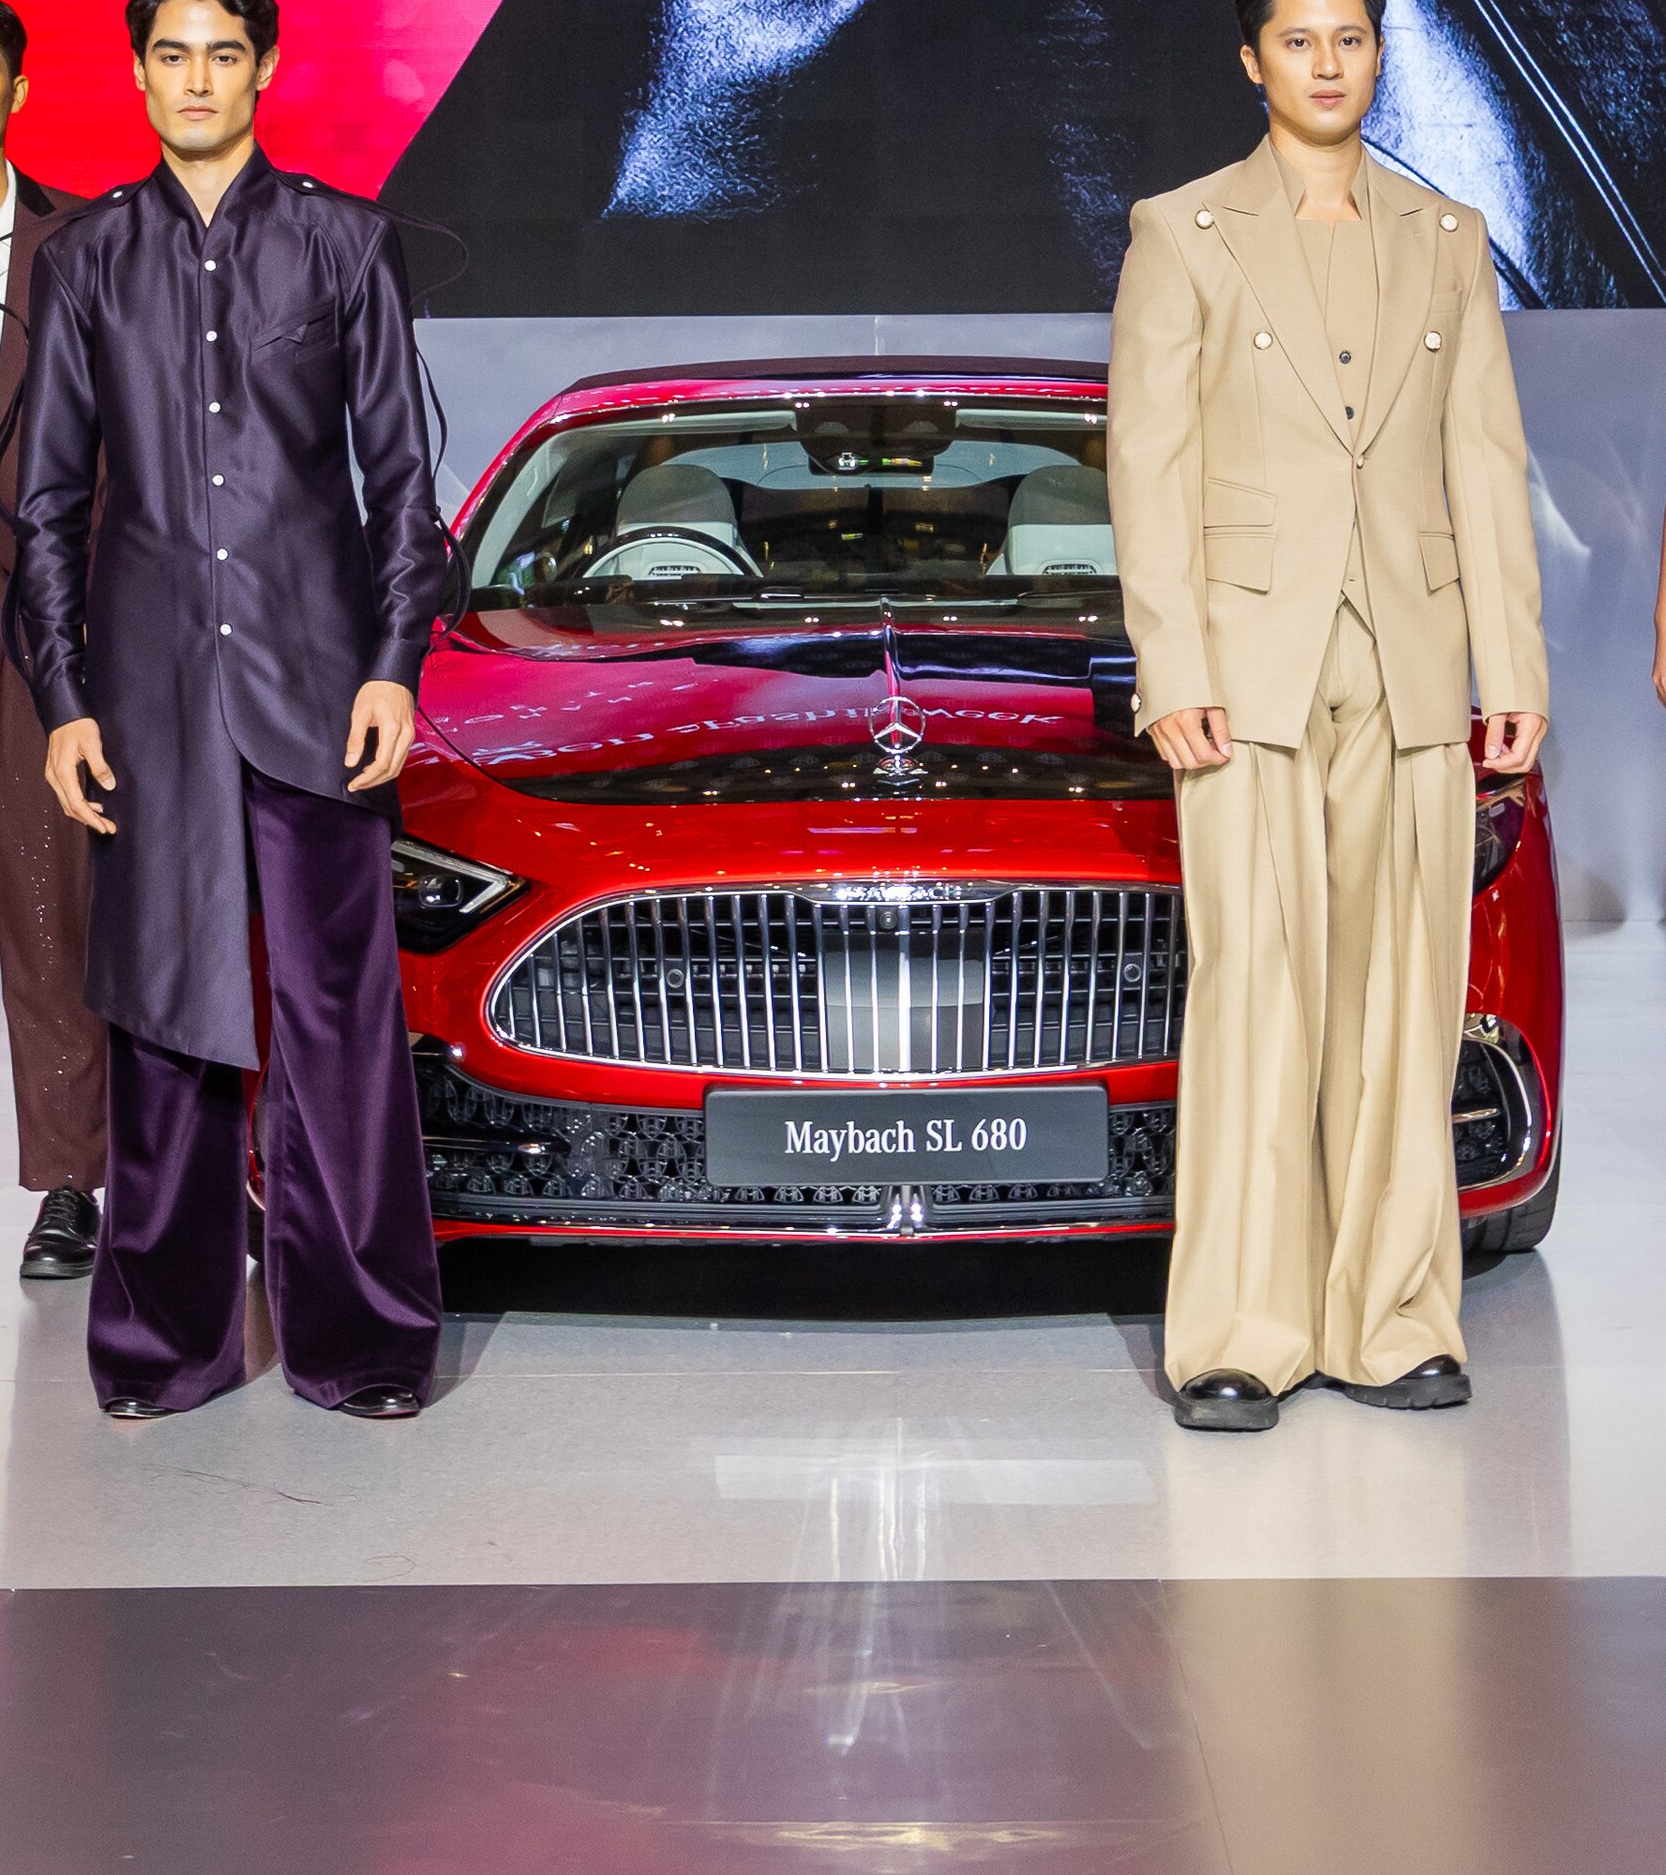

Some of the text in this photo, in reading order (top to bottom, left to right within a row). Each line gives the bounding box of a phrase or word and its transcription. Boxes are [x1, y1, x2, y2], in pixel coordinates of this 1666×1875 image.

[785, 1118, 1027, 1162] Maybach SL 680
